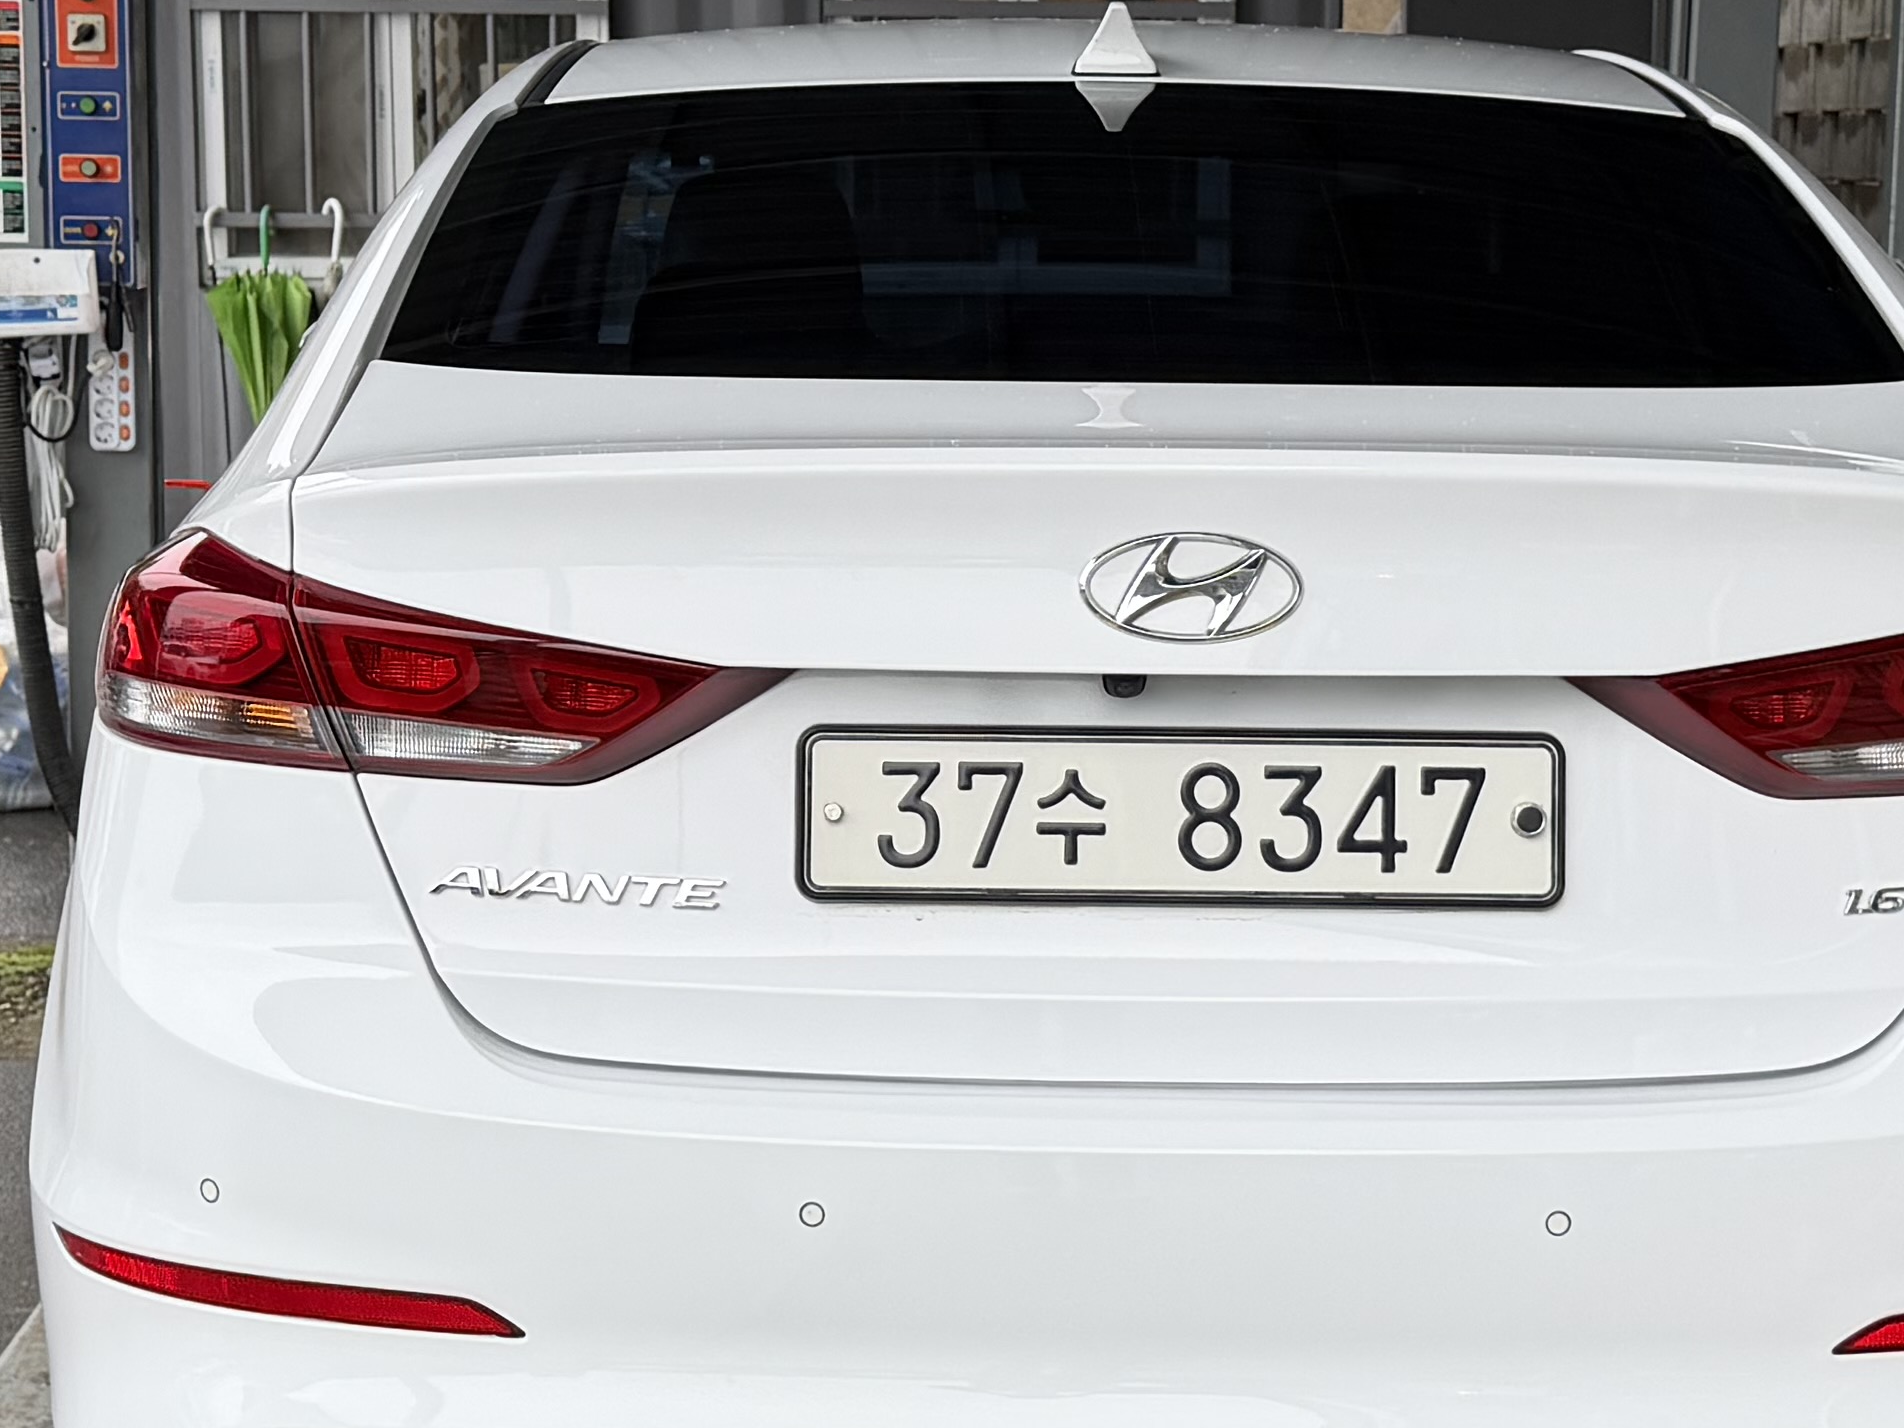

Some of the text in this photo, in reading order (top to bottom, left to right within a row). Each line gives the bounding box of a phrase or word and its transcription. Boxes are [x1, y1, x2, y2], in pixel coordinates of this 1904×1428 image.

[877, 761, 1486, 873] 37수 8347
[429, 866, 727, 910] AVANTE
